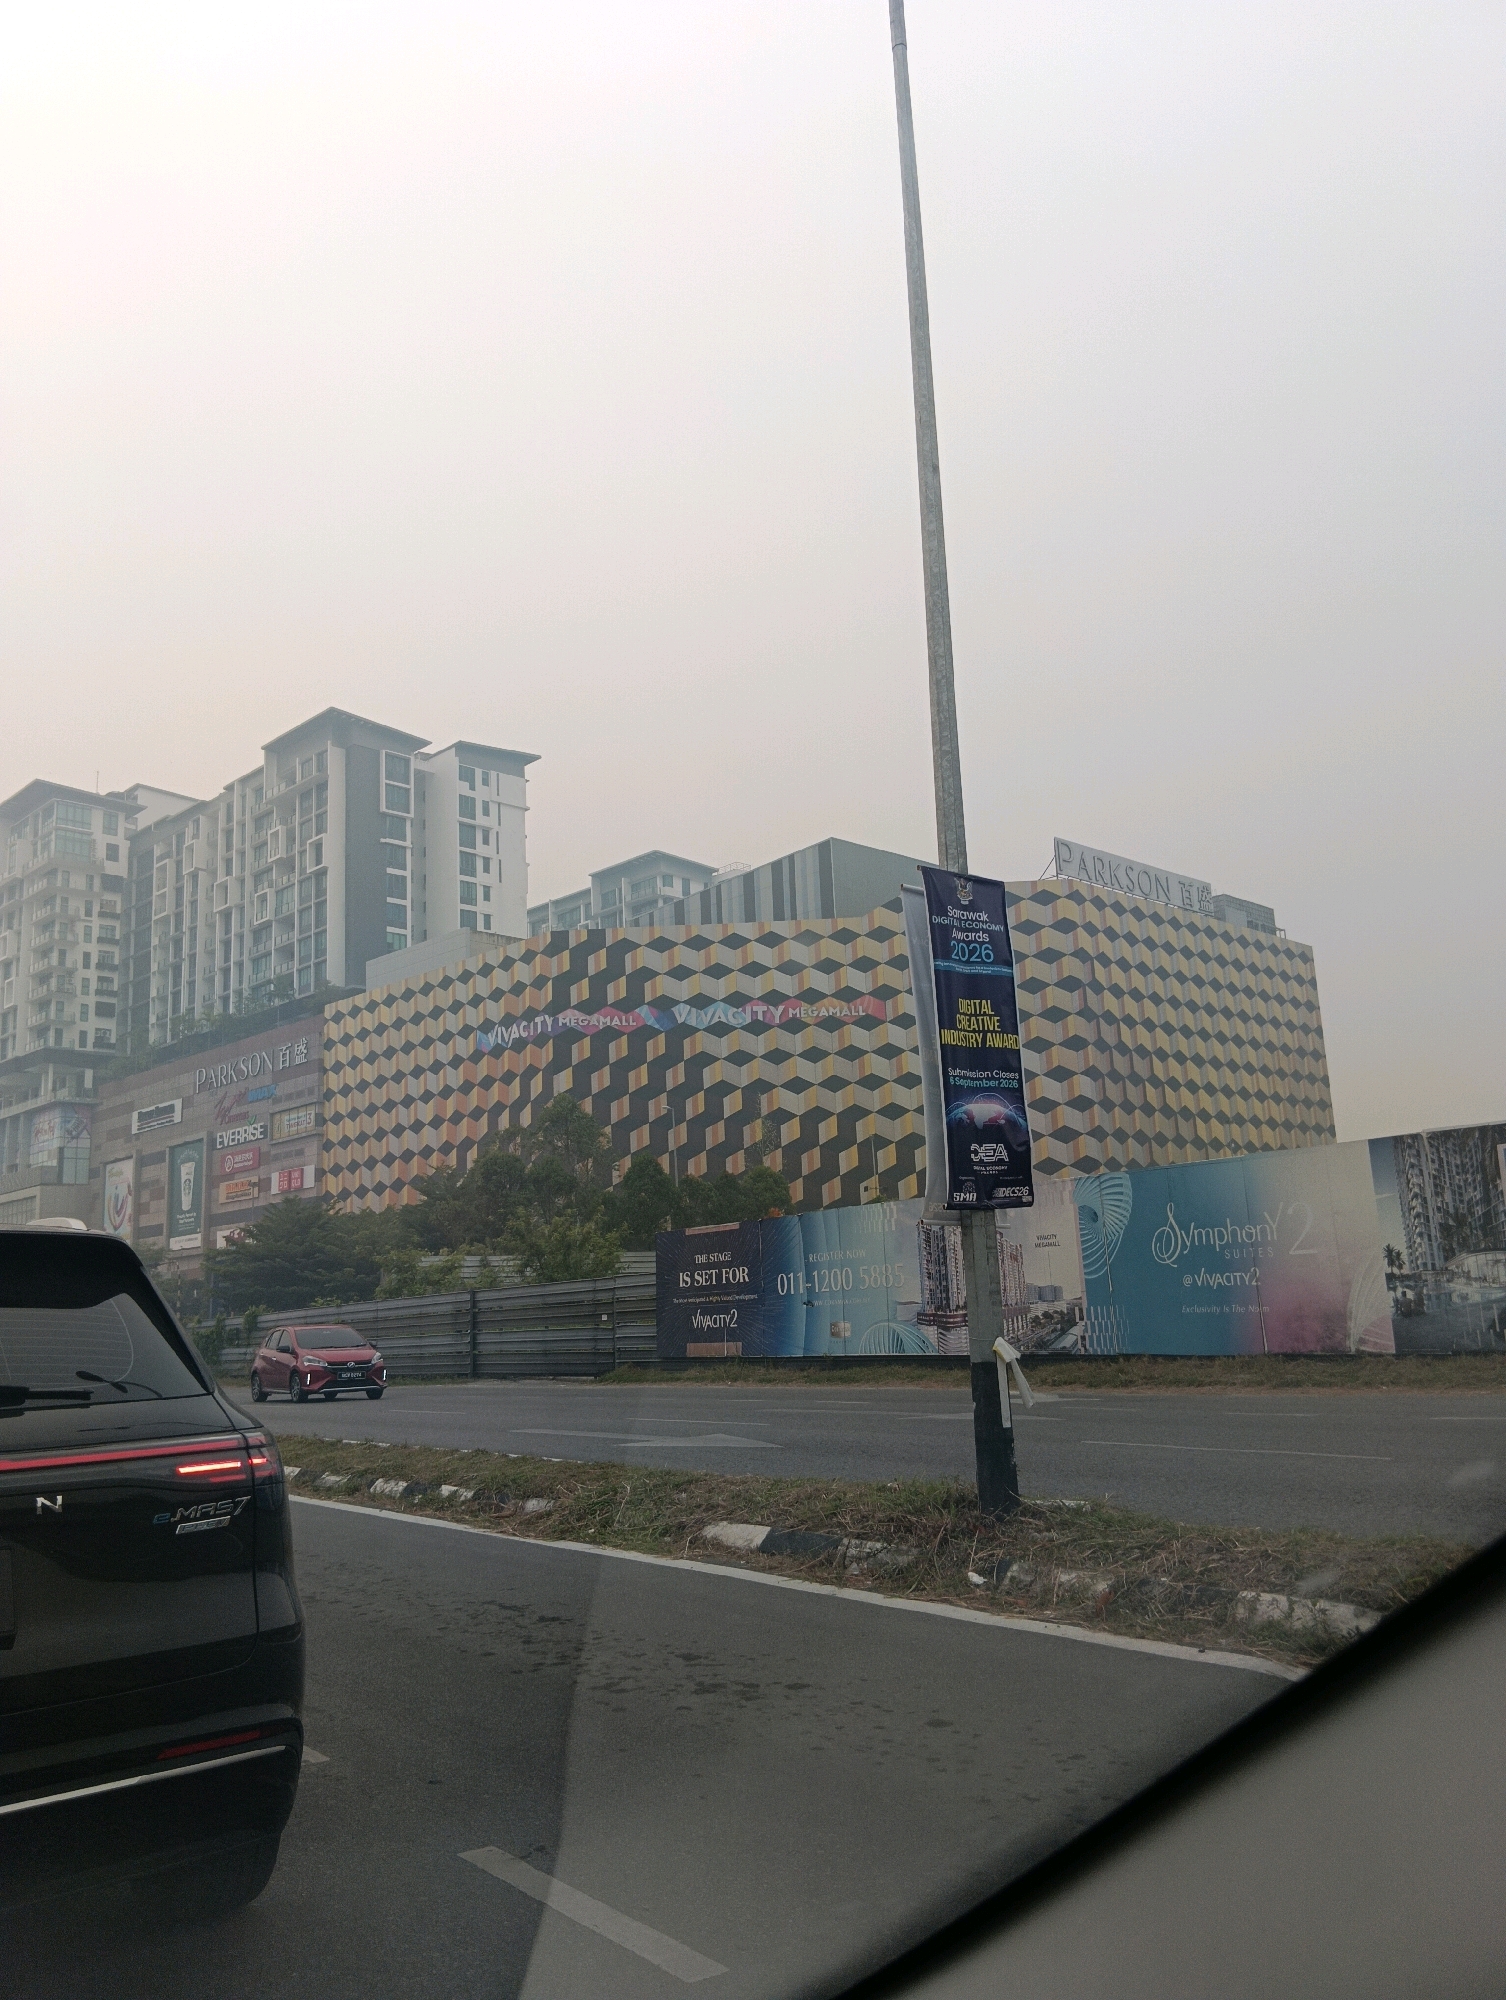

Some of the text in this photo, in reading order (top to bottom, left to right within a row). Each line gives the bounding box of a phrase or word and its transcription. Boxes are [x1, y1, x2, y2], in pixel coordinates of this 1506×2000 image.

[1056, 840, 1214, 913] PARKSON 百盛
[947, 905, 989, 922] Sarawak
[932, 915, 1004, 932] DIGITAL ECONOMY
[952, 928, 989, 942] Awards
[950, 940, 994, 963] 2026
[958, 998, 995, 1014] DIGITAL
[674, 1004, 865, 1026] VIVACITY MEGAMALL
[956, 1014, 1001, 1031] CREATIVE
[488, 1013, 636, 1048] VIVACITY MEGAMALL
[941, 1029, 982, 1048] INDUSTRY
[196, 1037, 308, 1094] PARKSON 百盛
[948, 1067, 1019, 1079] Submission Closes
[950, 1076, 1019, 1089] 6 September 2026
[216, 1122, 265, 1149] EVERRISE
[953, 1192, 977, 1202] SMA
[694, 1251, 731, 1264] THE STAGE
[808, 1249, 866, 1262] REGISTER NOW
[1224, 1247, 1274, 1259] SUITES
[679, 1266, 749, 1288] IS SET FOR
[777, 1263, 905, 1296] 011-1200 5885
[1181, 1304, 1220, 1315] Exclusivity
[1223, 1305, 1230, 1313] Is
[1232, 1304, 1246, 1313] The
